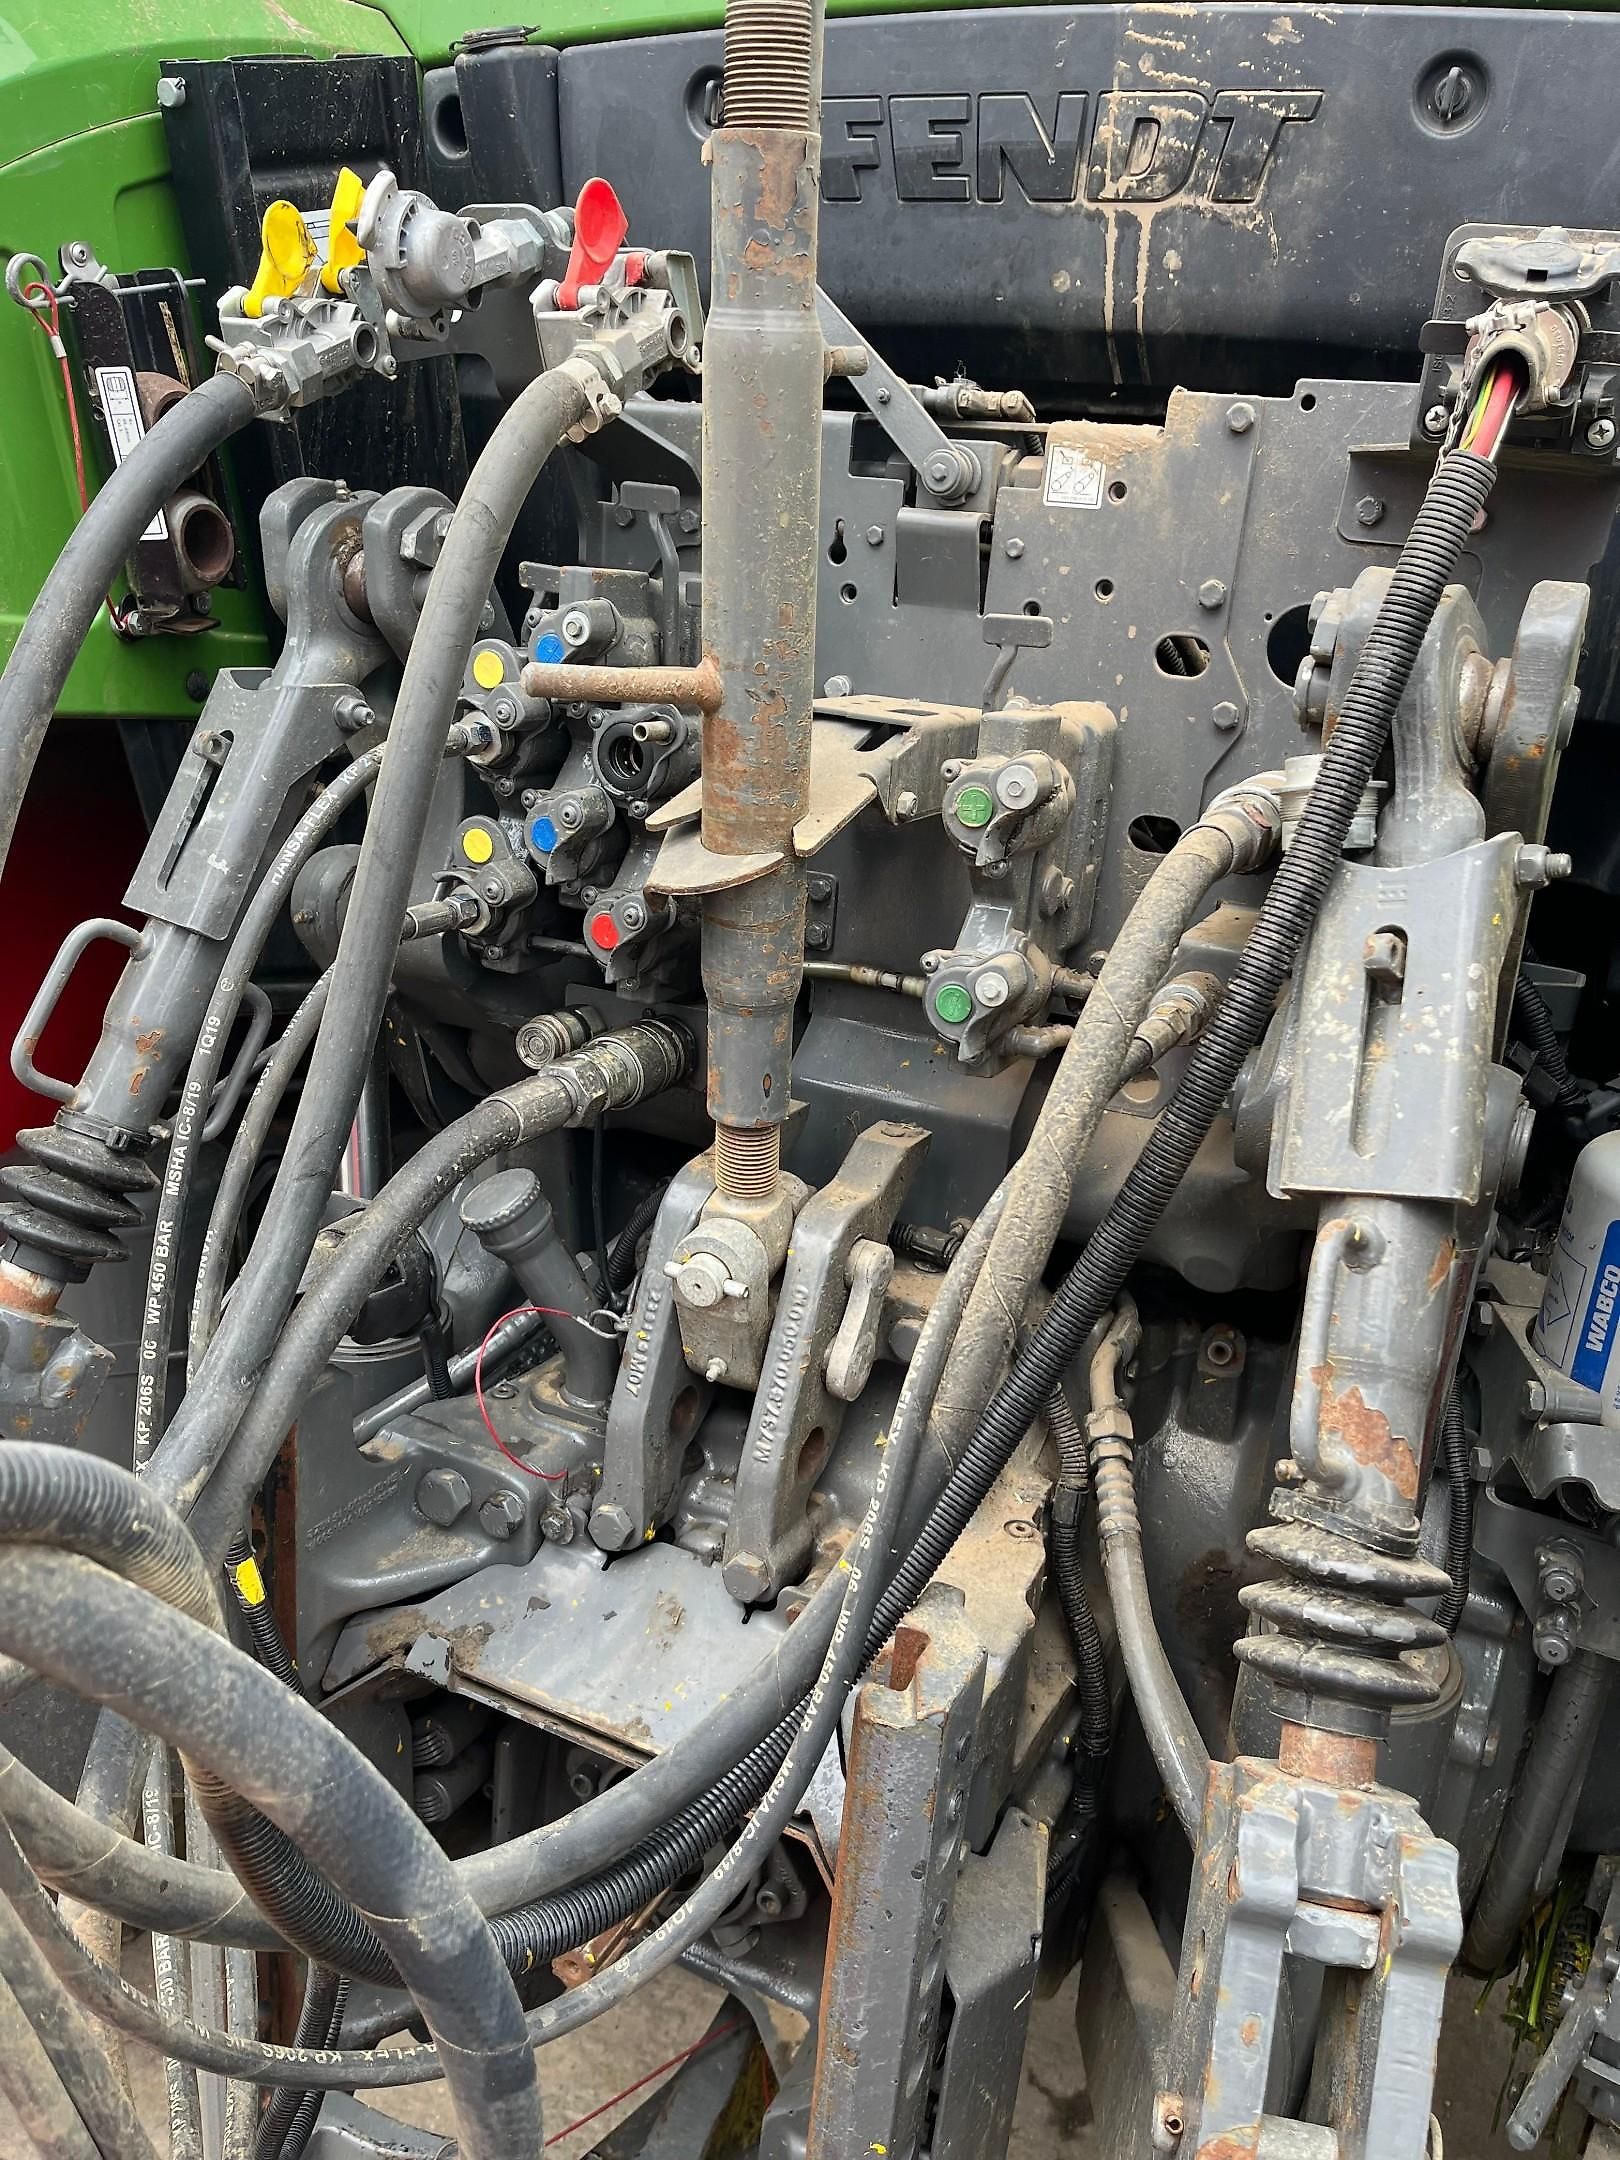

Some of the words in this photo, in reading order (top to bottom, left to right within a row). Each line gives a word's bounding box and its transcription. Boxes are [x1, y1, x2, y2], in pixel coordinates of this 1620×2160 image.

[821, 90, 1325, 205] FENDT
[339, 765, 361, 786] KP
[199, 1015, 221, 1056] 1Q19
[177, 1081, 202, 1140] IC-8/19
[166, 1145, 188, 1197] MSHA
[155, 1220, 174, 1258] BAR
[150, 1262, 168, 1294] 450
[147, 1297, 162, 1325] WP
[1585, 1264, 1620, 1352] WABCO
[138, 1374, 154, 1417] 206S
[137, 1421, 152, 1445] KP
[860, 1496, 881, 1550] 206S
[155, 1935, 172, 1976] BAR
